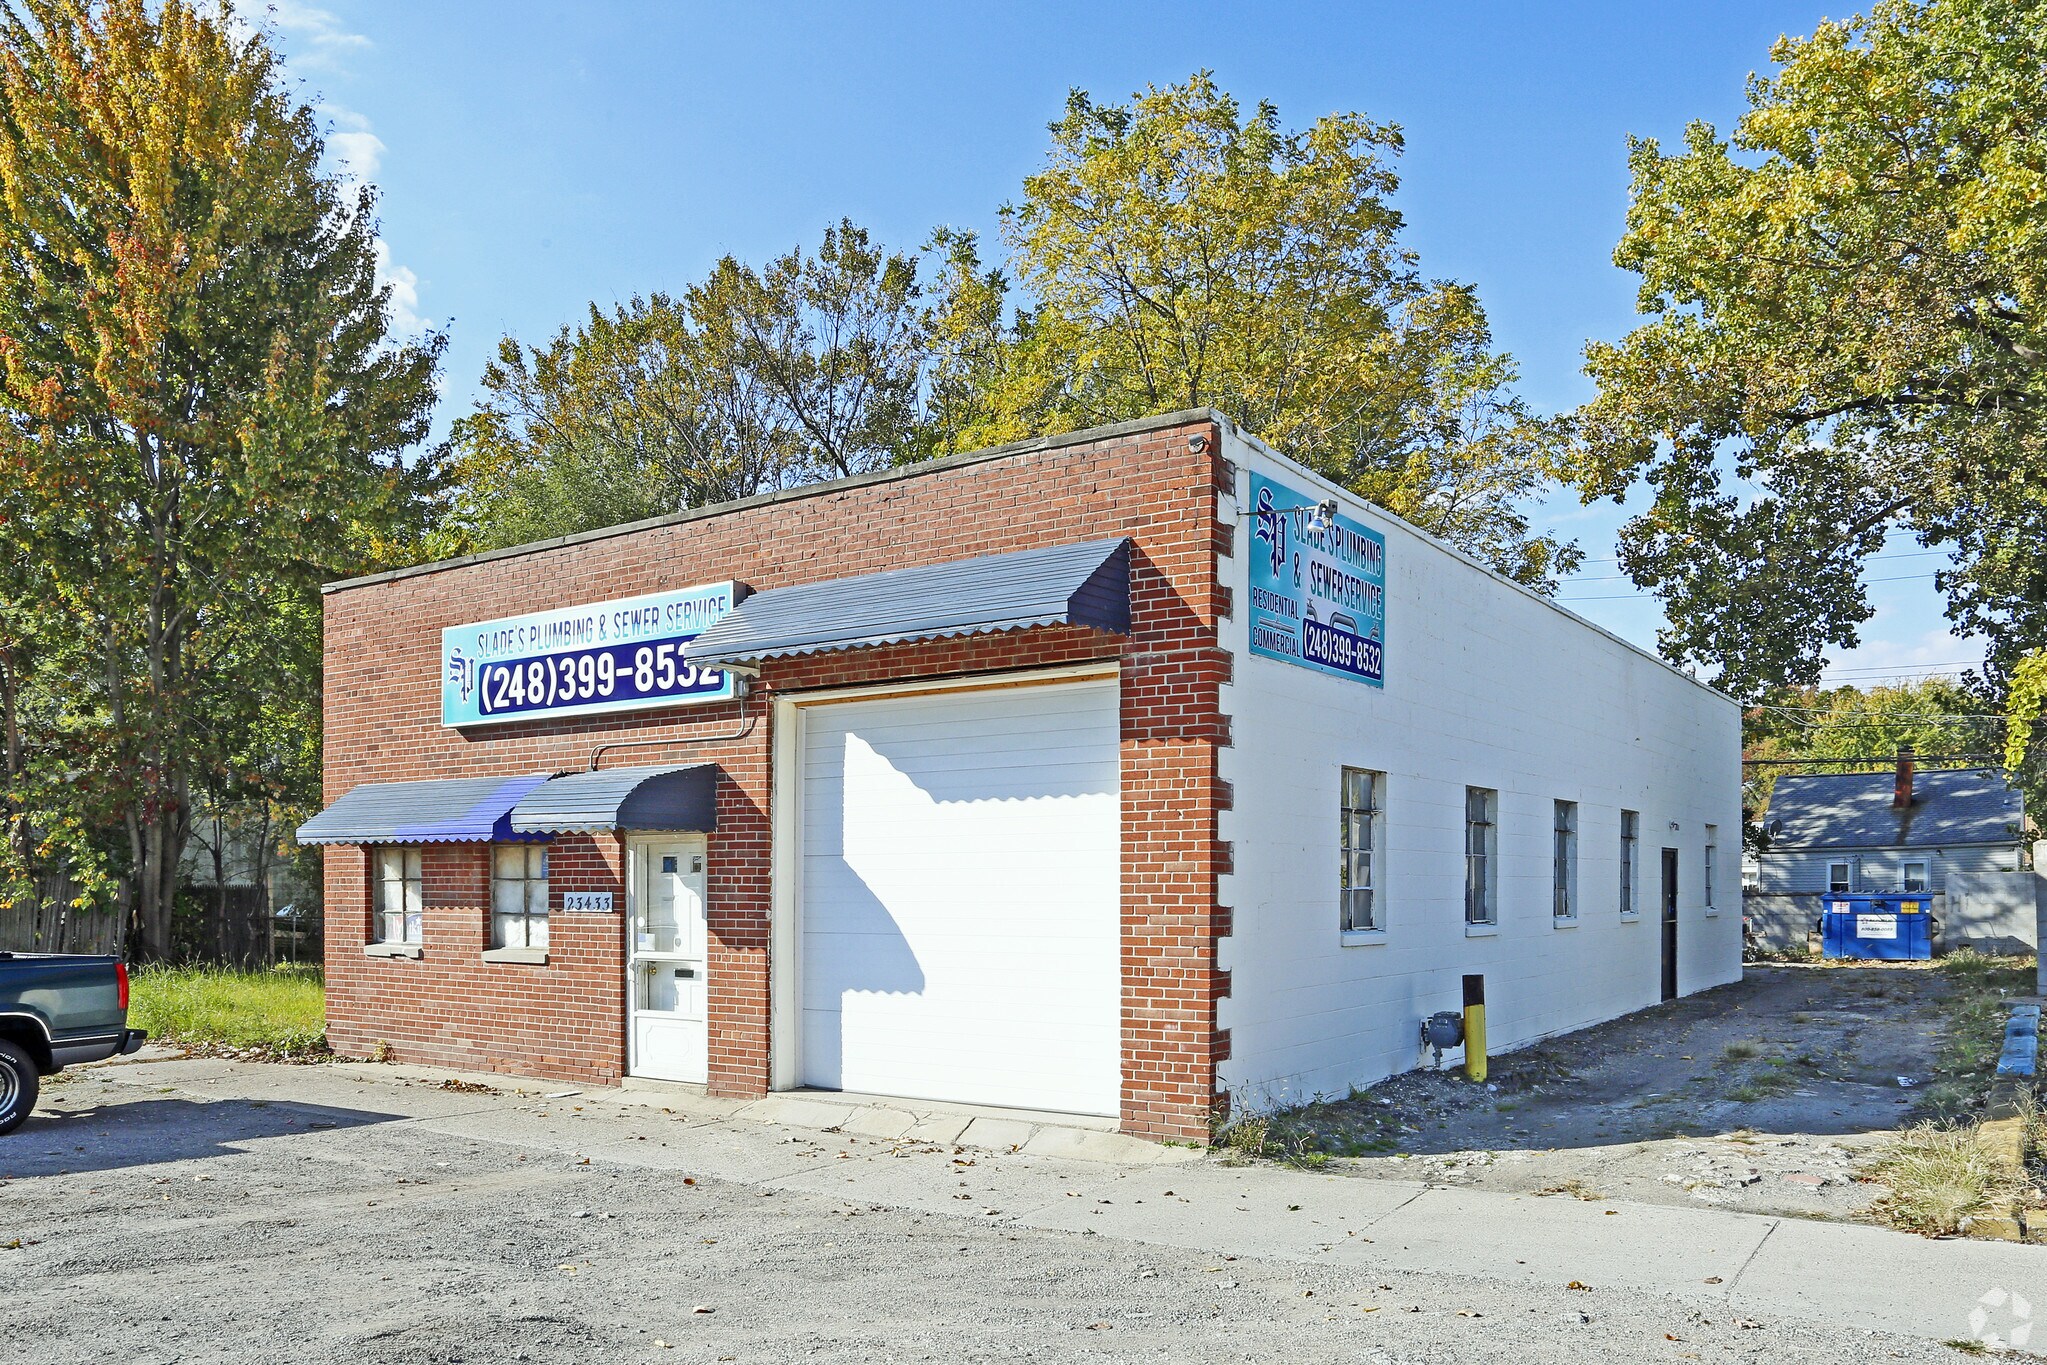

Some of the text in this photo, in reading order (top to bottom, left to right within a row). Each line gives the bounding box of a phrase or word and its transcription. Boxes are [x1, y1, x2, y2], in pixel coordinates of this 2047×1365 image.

[1293, 505, 1382, 576] SLADES PLUMBING
[1252, 586, 1299, 620] RESIDENTIAL
[1293, 552, 1382, 619] & SEWER SERVICE
[477, 596, 726, 658] SLADE'S PLUMBING & SEWER SERVICE
[1252, 626, 1300, 657] COMMERCIAL
[1304, 622, 1381, 675] (248)399-8532
[567, 896, 610, 910] 23433
